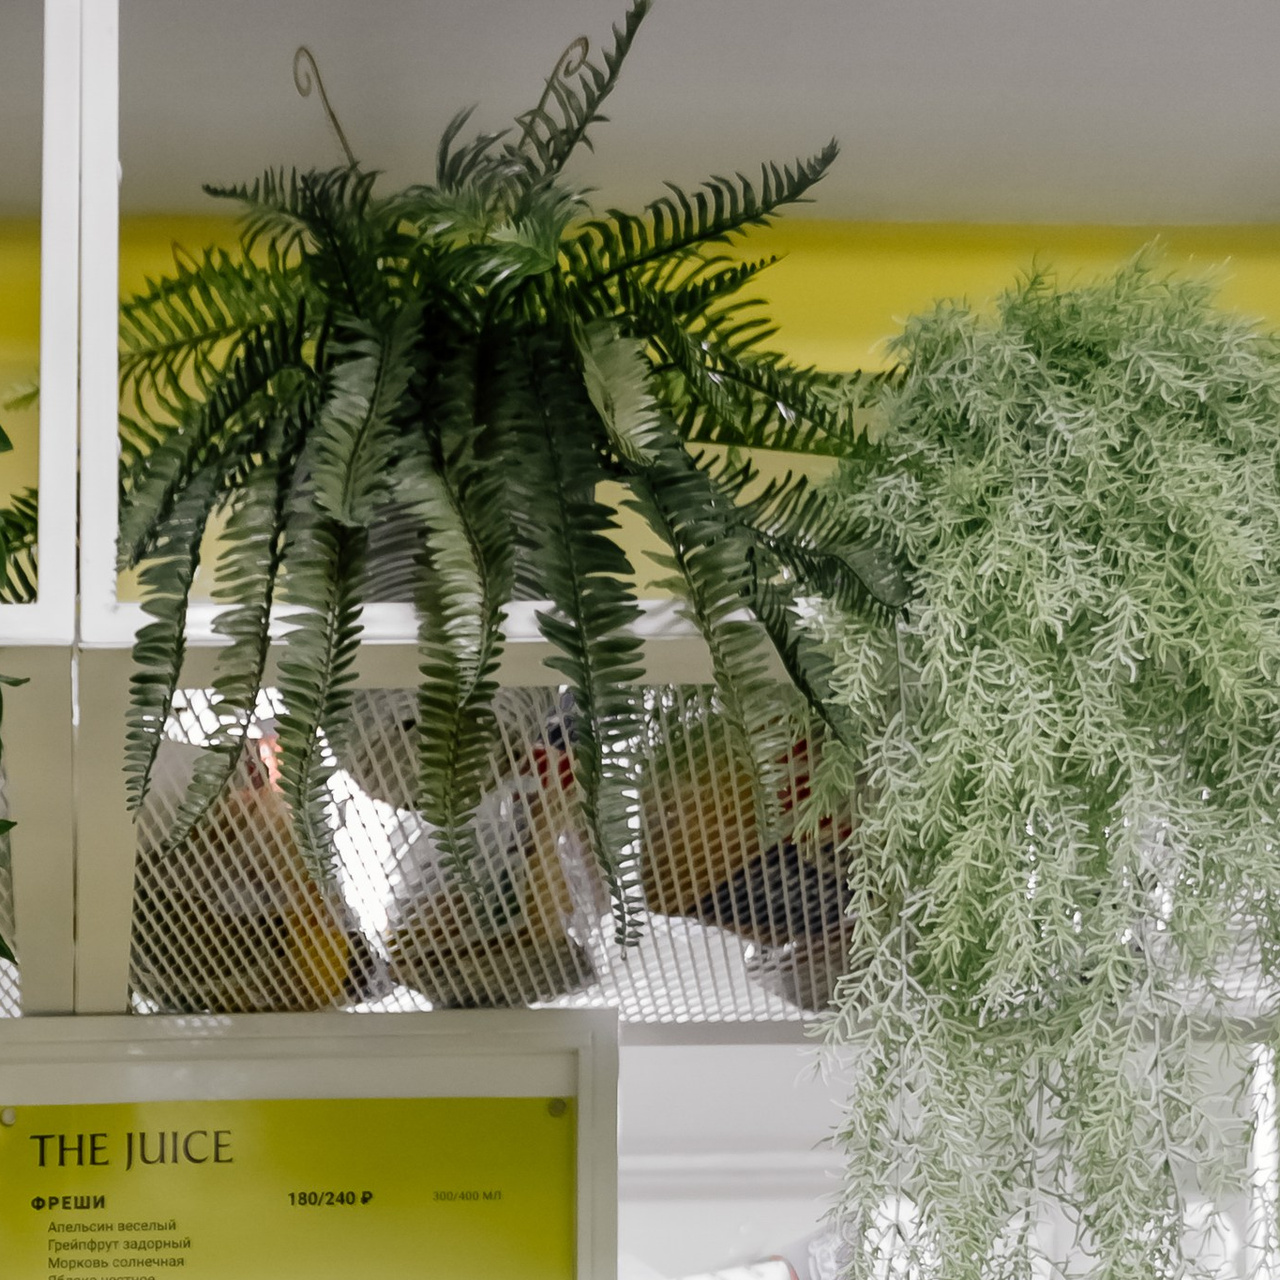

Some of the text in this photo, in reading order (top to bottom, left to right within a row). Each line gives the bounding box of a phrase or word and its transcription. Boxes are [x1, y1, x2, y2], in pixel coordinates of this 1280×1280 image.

[29, 1130, 234, 1172] THE JUICE
[30, 1195, 106, 1211] ФРЕШИ
[288, 1190, 357, 1207] 180/240
[47, 1218, 177, 1233] Апельсин веселый
[47, 1236, 191, 1254] Грейпфрут задорный
[47, 1256, 185, 1271] Морковь солнечная
